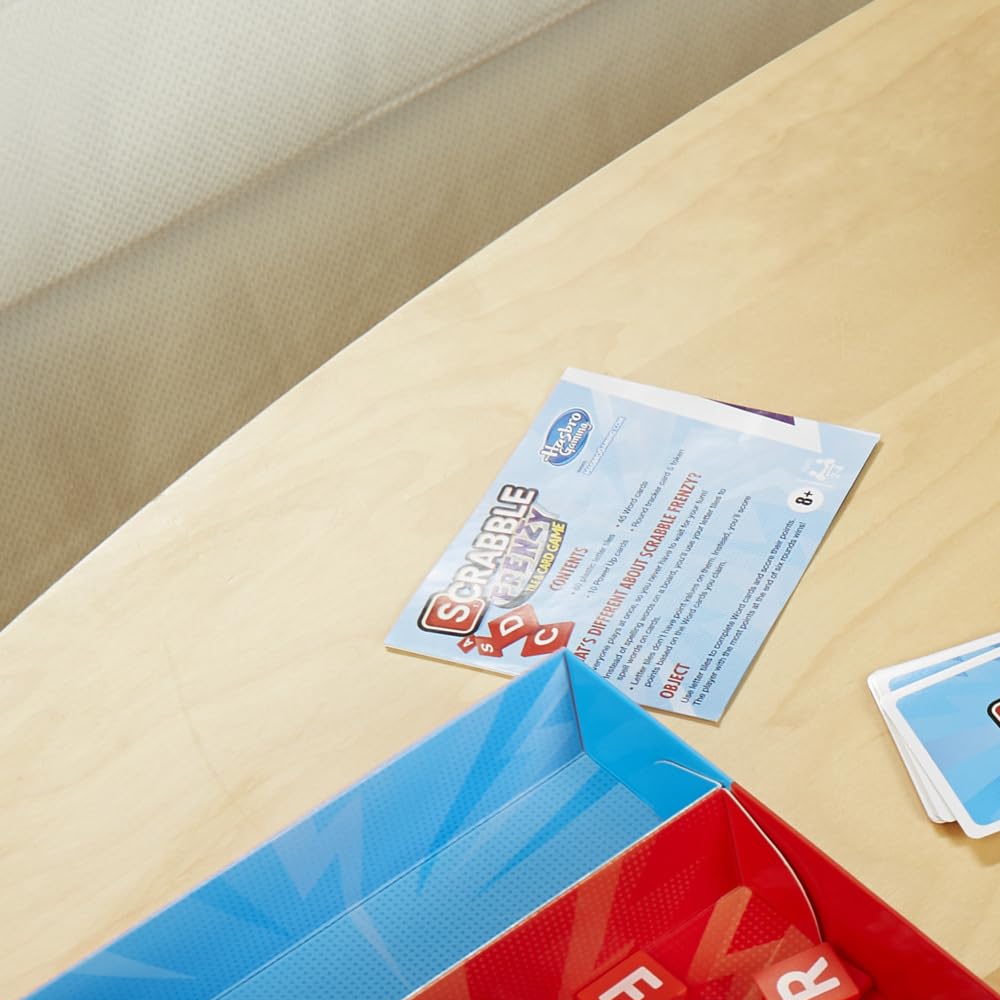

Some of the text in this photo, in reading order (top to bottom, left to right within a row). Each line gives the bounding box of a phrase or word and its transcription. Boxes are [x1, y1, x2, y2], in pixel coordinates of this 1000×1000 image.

[541, 412, 581, 462] Hasbro
[560, 423, 592, 456] Gaming
[796, 492, 813, 506] 8+
[439, 486, 537, 623] SCRABBLE
[490, 507, 552, 601] FRENZY
[540, 554, 554, 572] CARD
[548, 524, 565, 551] GAME
[588, 590, 628, 636] DIFFERENT
[620, 559, 648, 590] ABOUT
[640, 514, 677, 558] SCRABBLE
[668, 473, 701, 513] FRENZY?
[550, 548, 588, 591] CONTENTS
[465, 637, 472, 648] A
[500, 615, 523, 636] D
[535, 627, 558, 645] C
[481, 642, 493, 651] S
[660, 663, 690, 699] OBJECT
